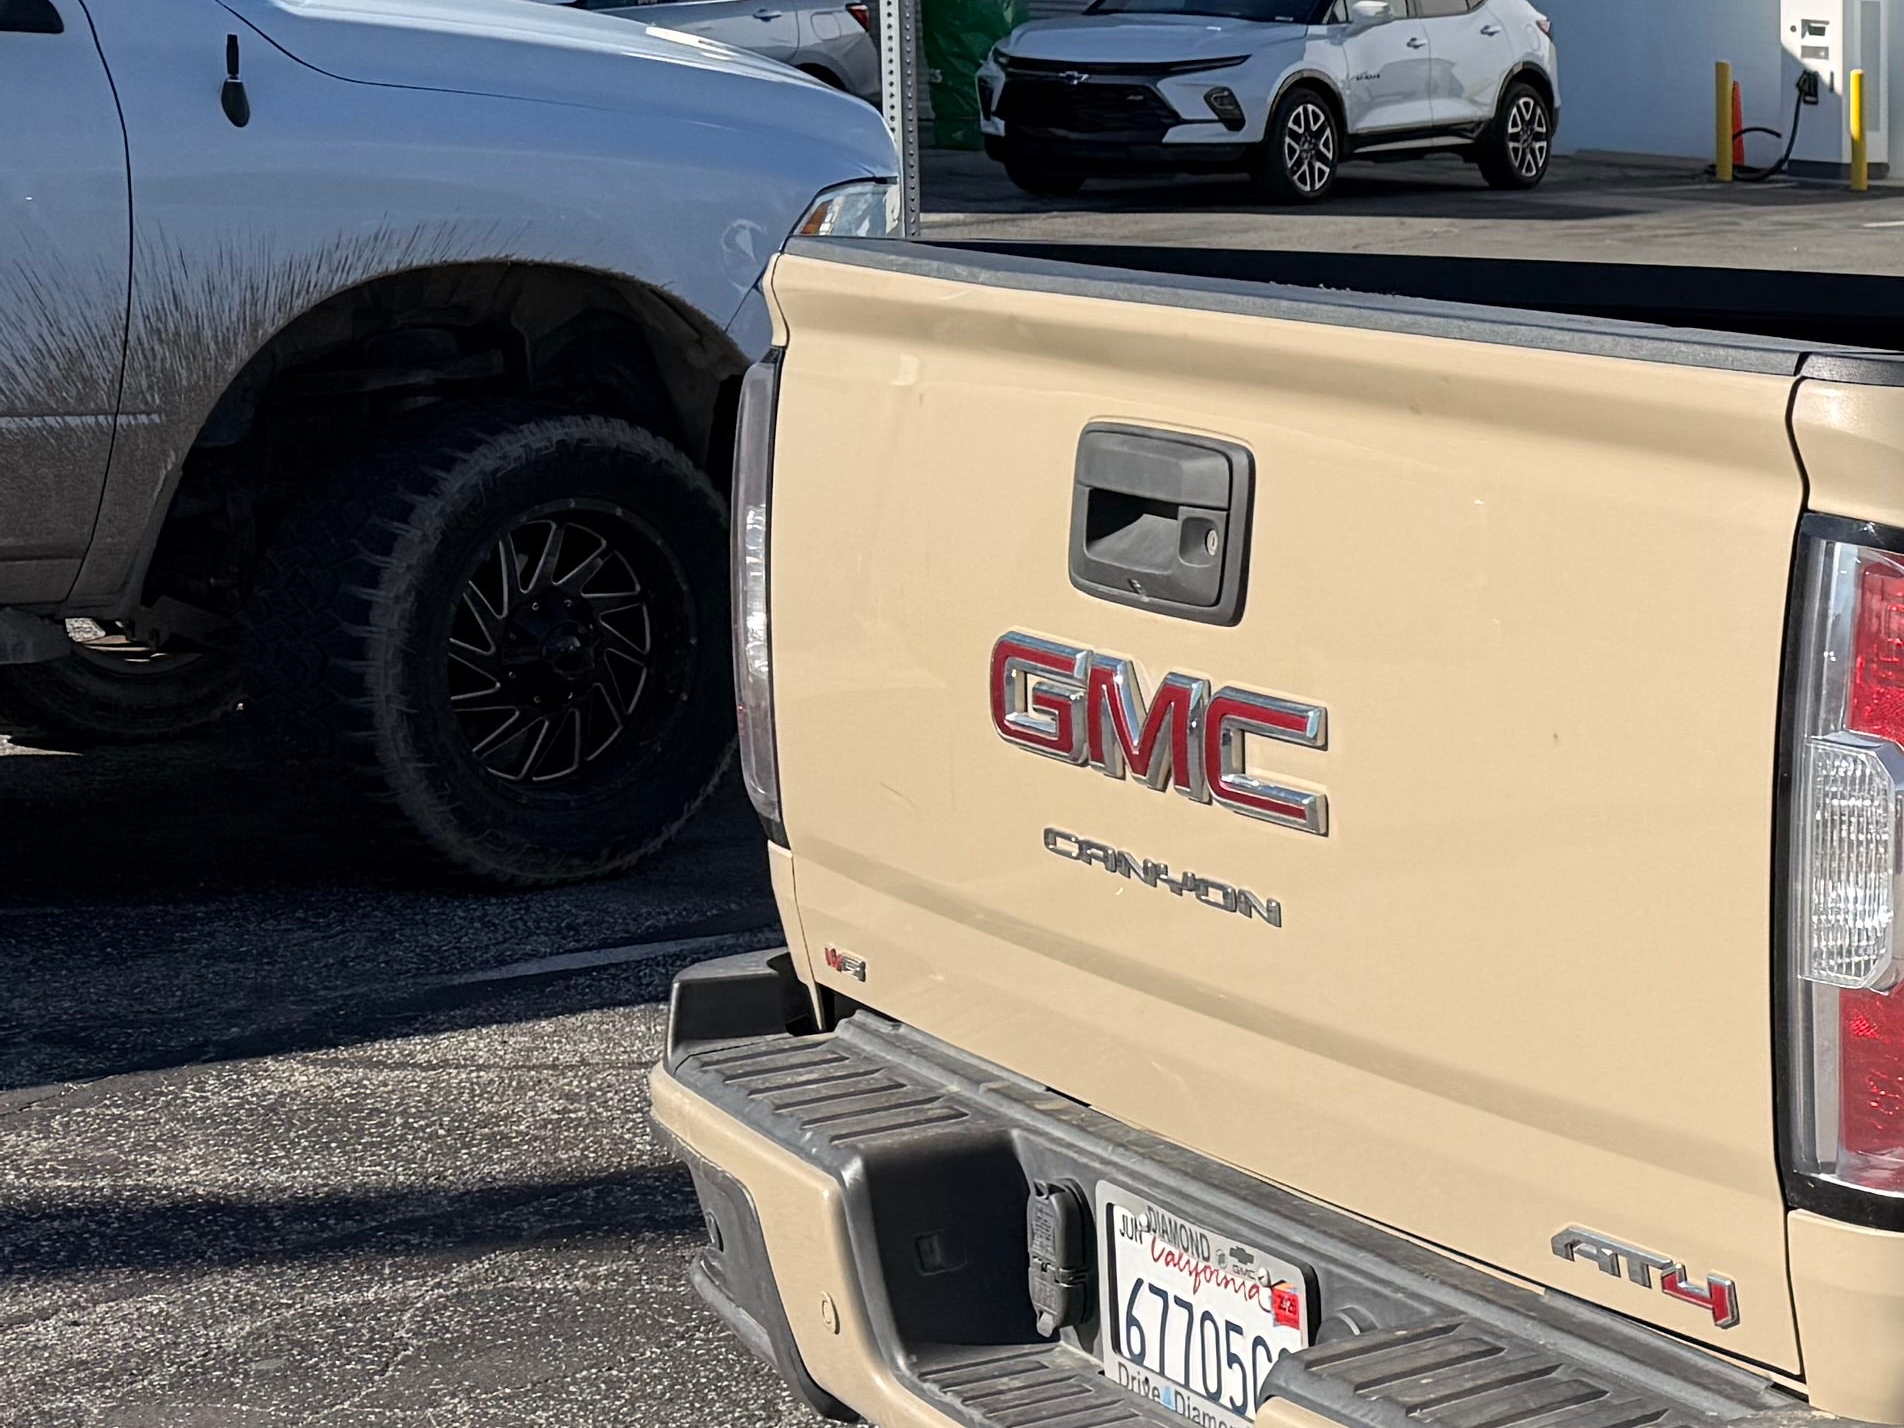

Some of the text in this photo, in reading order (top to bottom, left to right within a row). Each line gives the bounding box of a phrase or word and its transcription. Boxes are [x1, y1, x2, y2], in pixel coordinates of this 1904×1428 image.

[989, 631, 1329, 838] GMC
[1043, 827, 1282, 928] CANYON
[1146, 1206, 1211, 1263] DIAMOND
[1151, 1236, 1271, 1313] California
[1551, 1227, 1740, 1330] AT4
[1118, 1363, 1161, 1402] Drive
